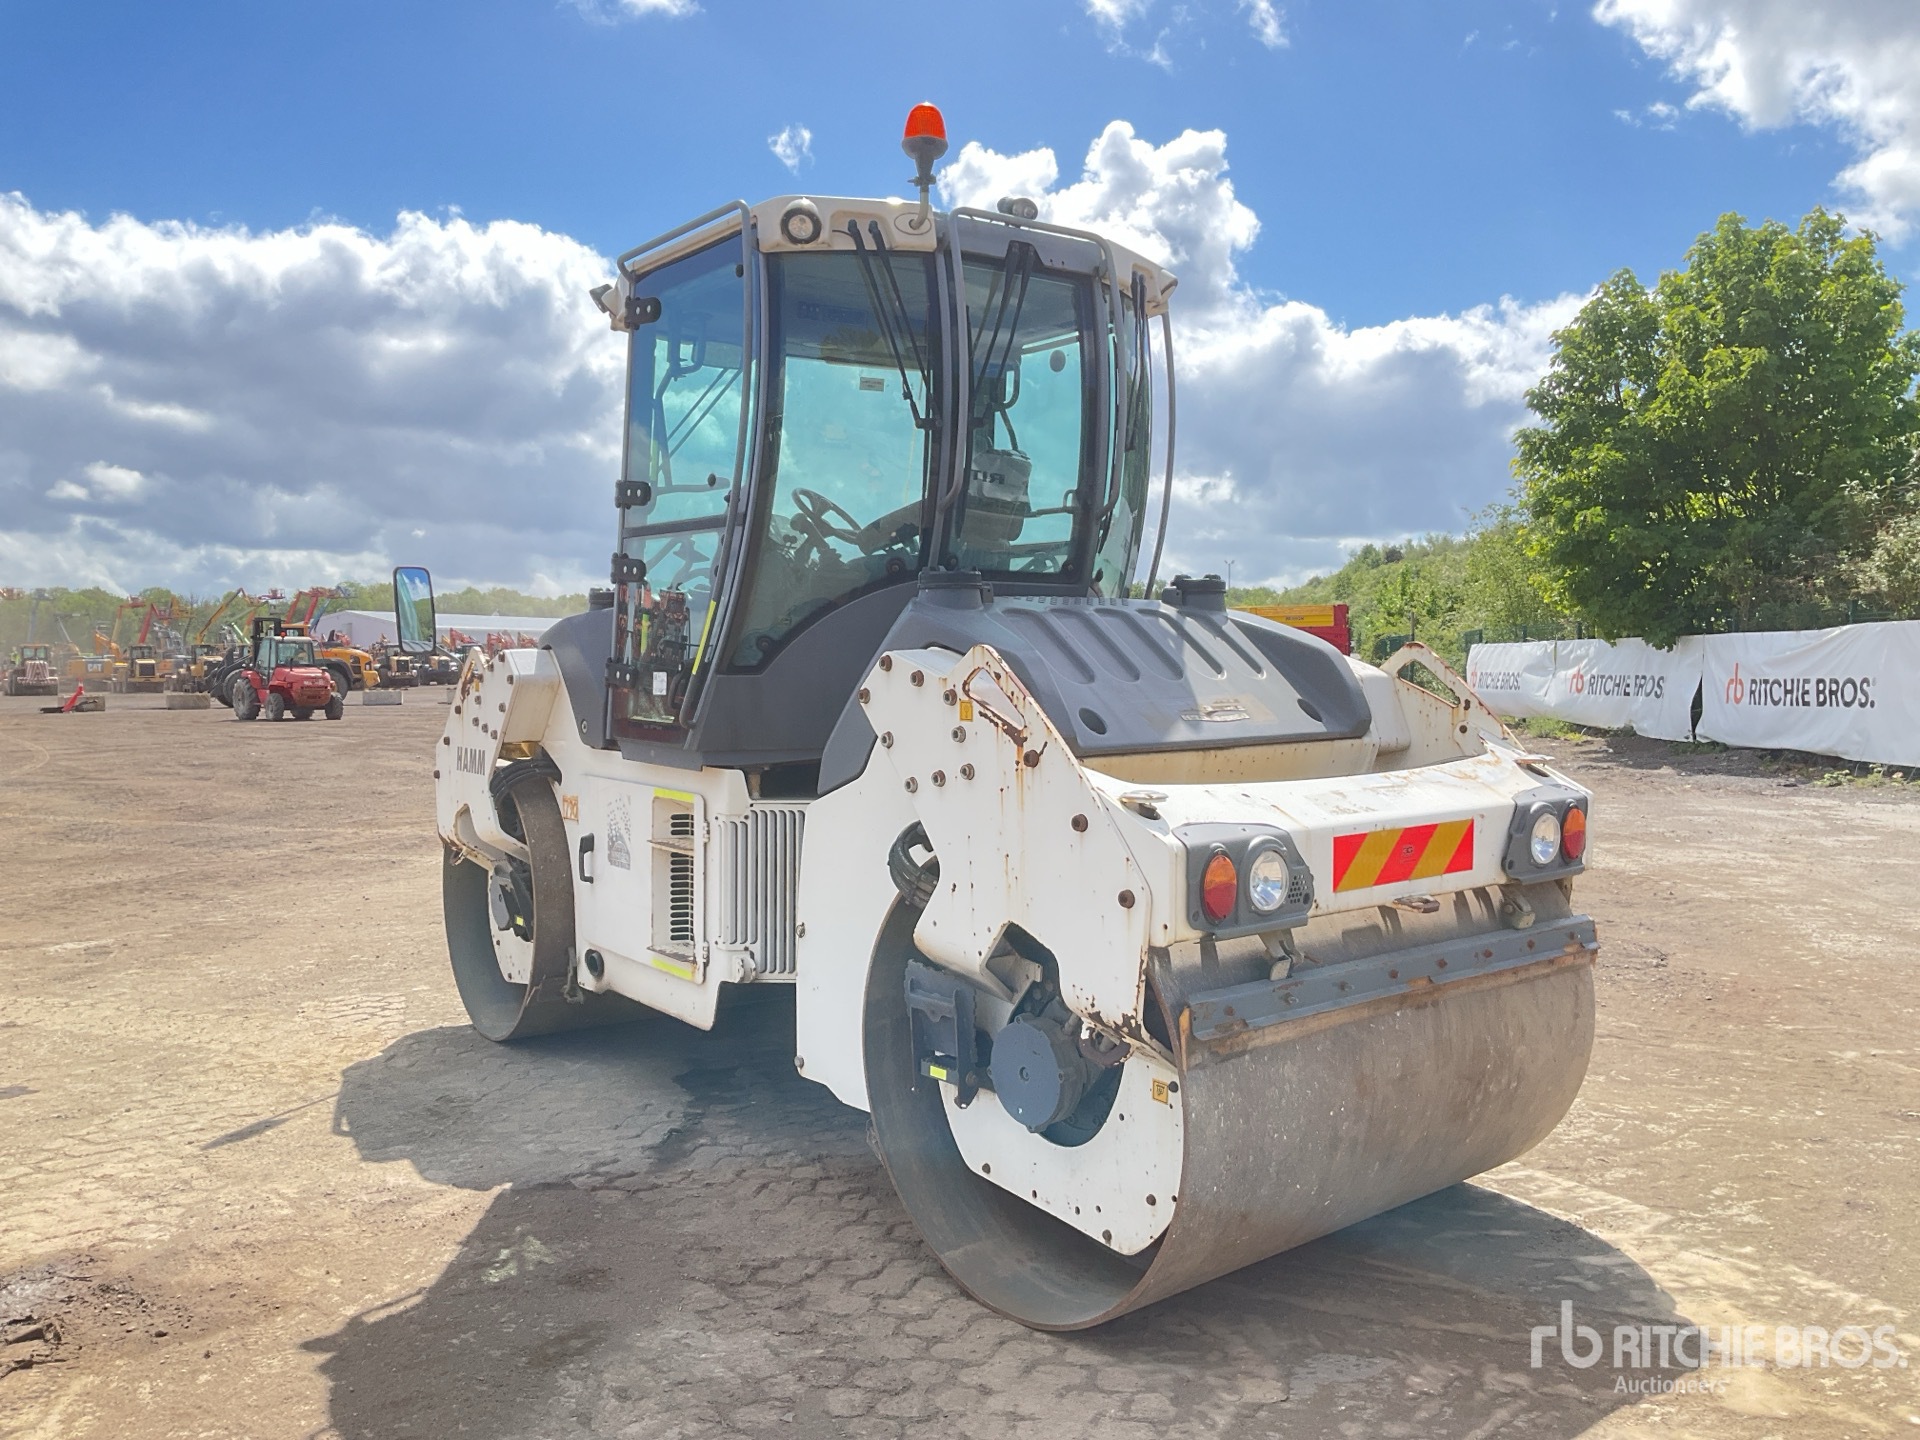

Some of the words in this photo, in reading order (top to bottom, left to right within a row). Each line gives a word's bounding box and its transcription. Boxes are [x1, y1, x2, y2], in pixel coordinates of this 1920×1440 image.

[1587, 674, 1631, 697] RITCHIE
[1725, 663, 1745, 705] rb
[1749, 678, 1811, 707] RITCHIE
[1815, 677, 1876, 708] BROS.
[456, 746, 486, 776] HAMM
